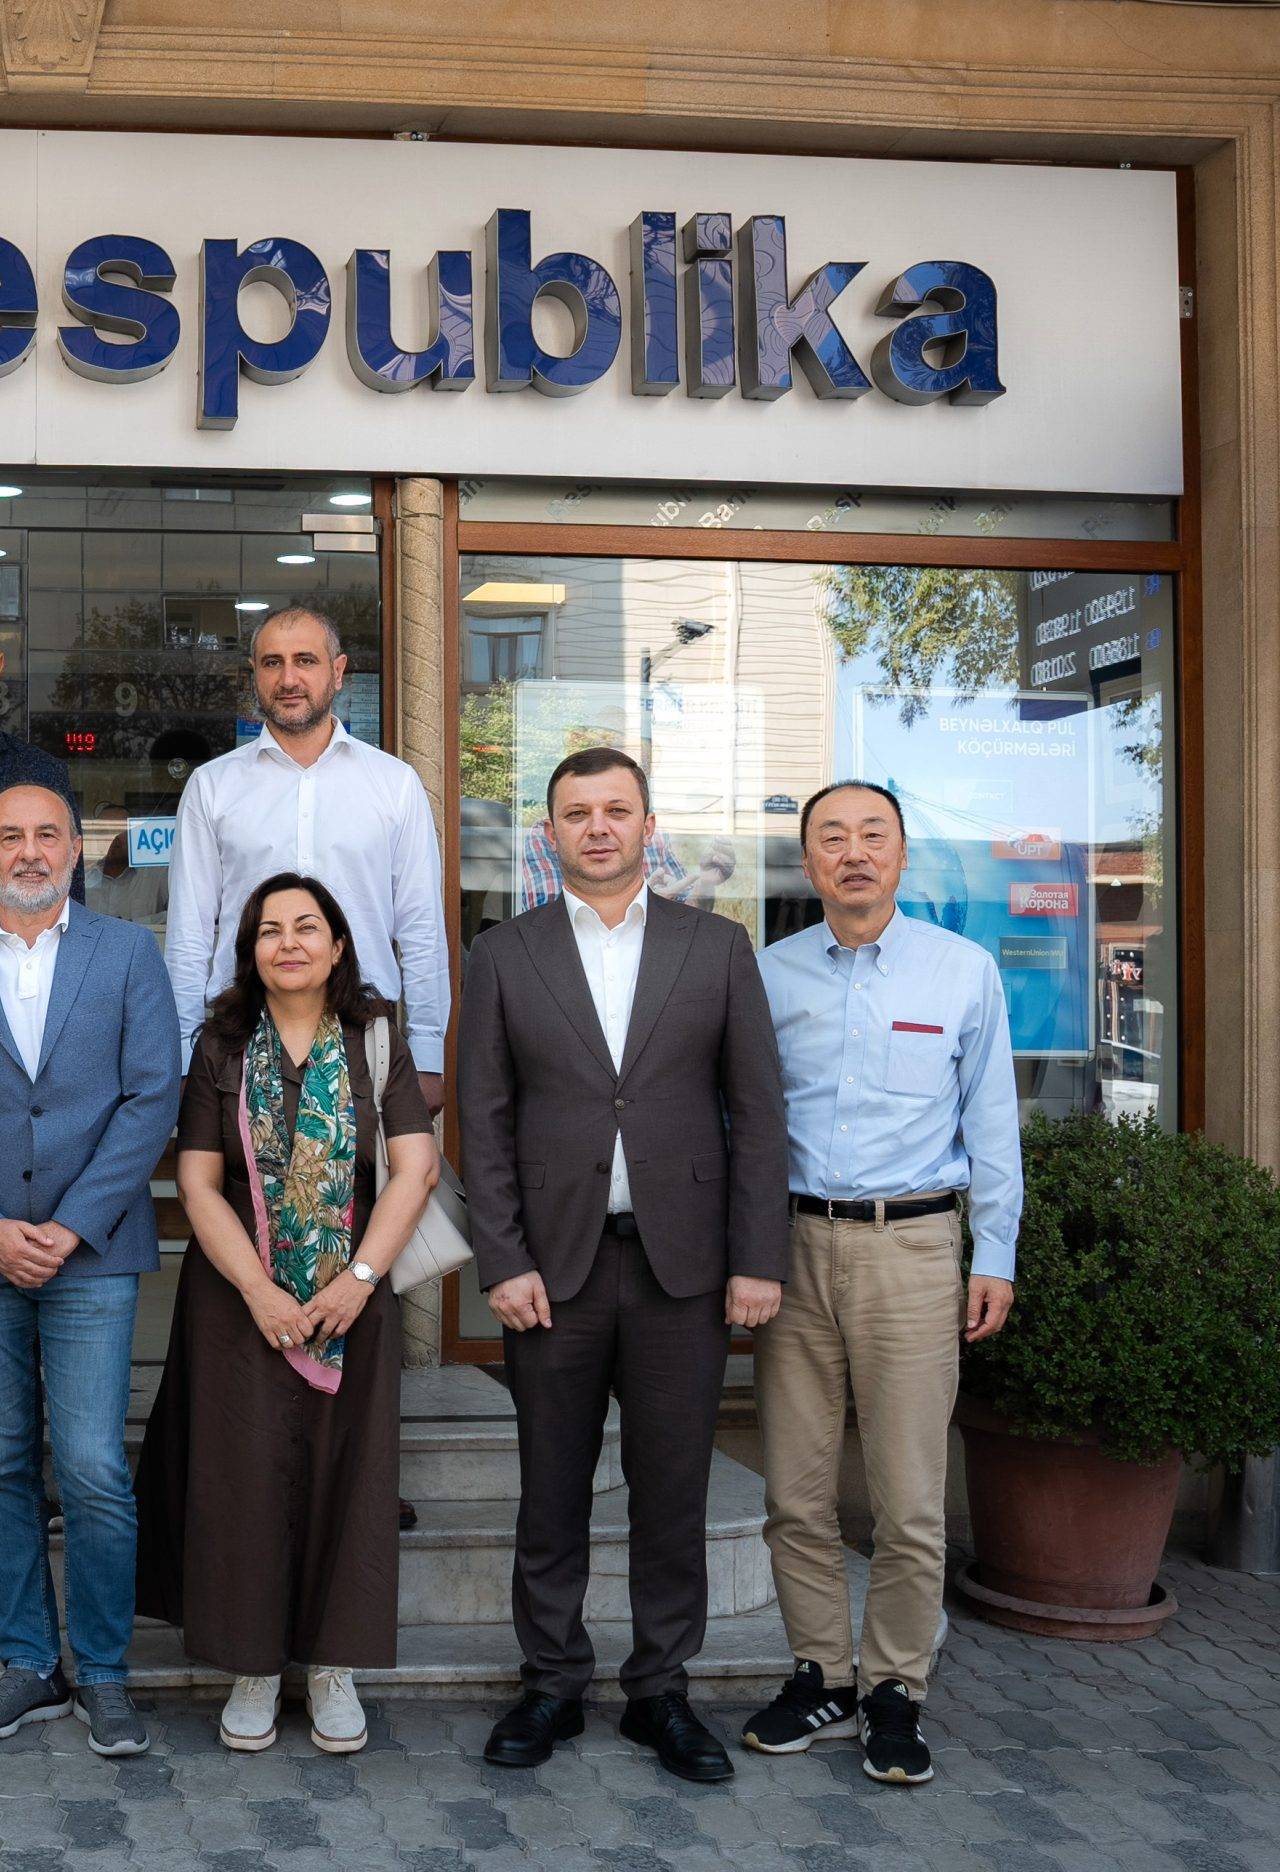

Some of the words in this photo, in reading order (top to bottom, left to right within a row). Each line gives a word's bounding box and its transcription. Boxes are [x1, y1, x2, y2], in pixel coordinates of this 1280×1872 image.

[115, 682, 138, 717] 9
[939, 718, 1043, 735] BEYNƏLXALQ
[1047, 720, 1076, 735] PUL
[957, 737, 1076, 758] KÖÇÜRMƏLƏRİ
[1030, 889, 1069, 900] Золотая
[1021, 899, 1069, 911] Корона
